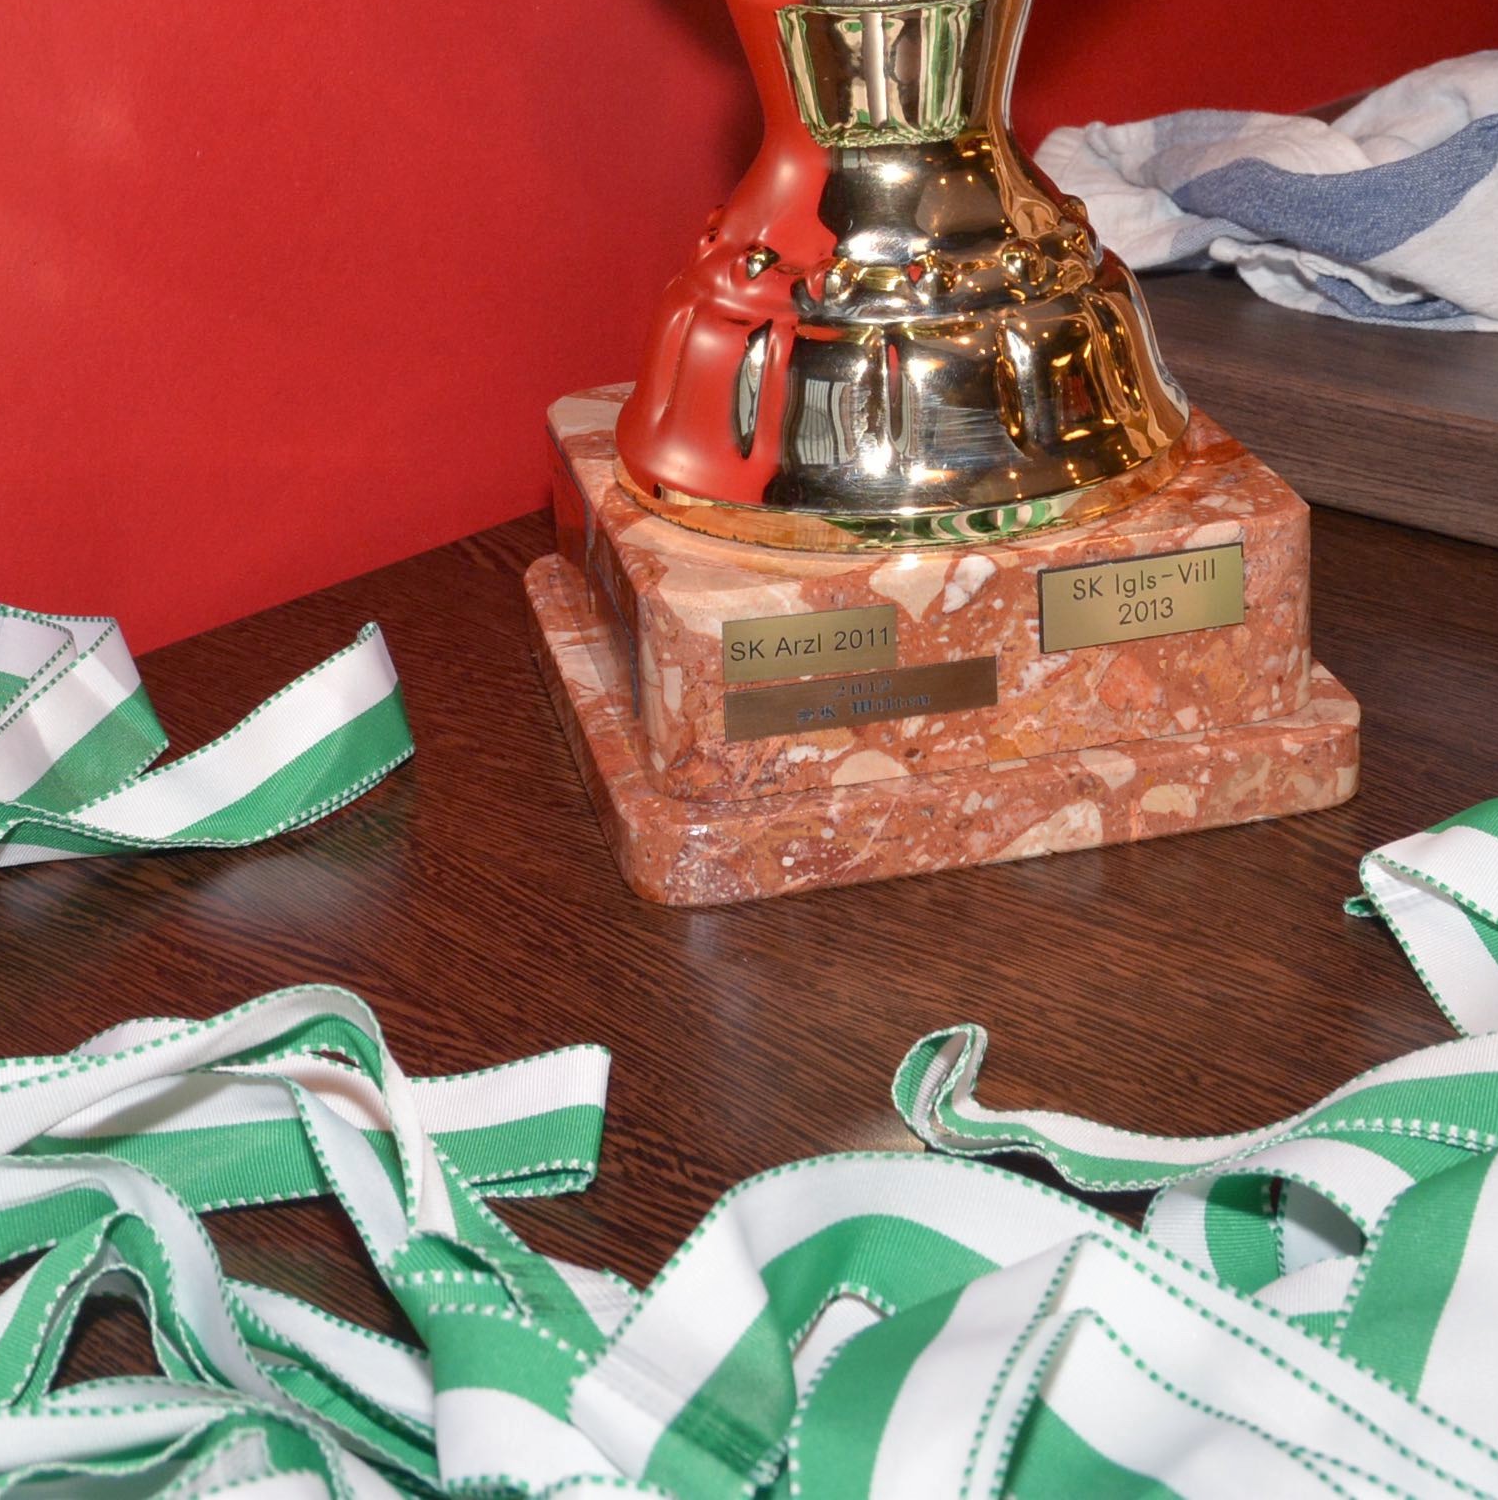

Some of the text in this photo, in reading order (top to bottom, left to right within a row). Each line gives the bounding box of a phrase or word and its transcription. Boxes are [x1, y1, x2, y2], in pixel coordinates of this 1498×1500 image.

[1072, 574, 1103, 601] SK
[1117, 596, 1174, 625] 2013
[729, 626, 889, 662] SK Arzl 2011
